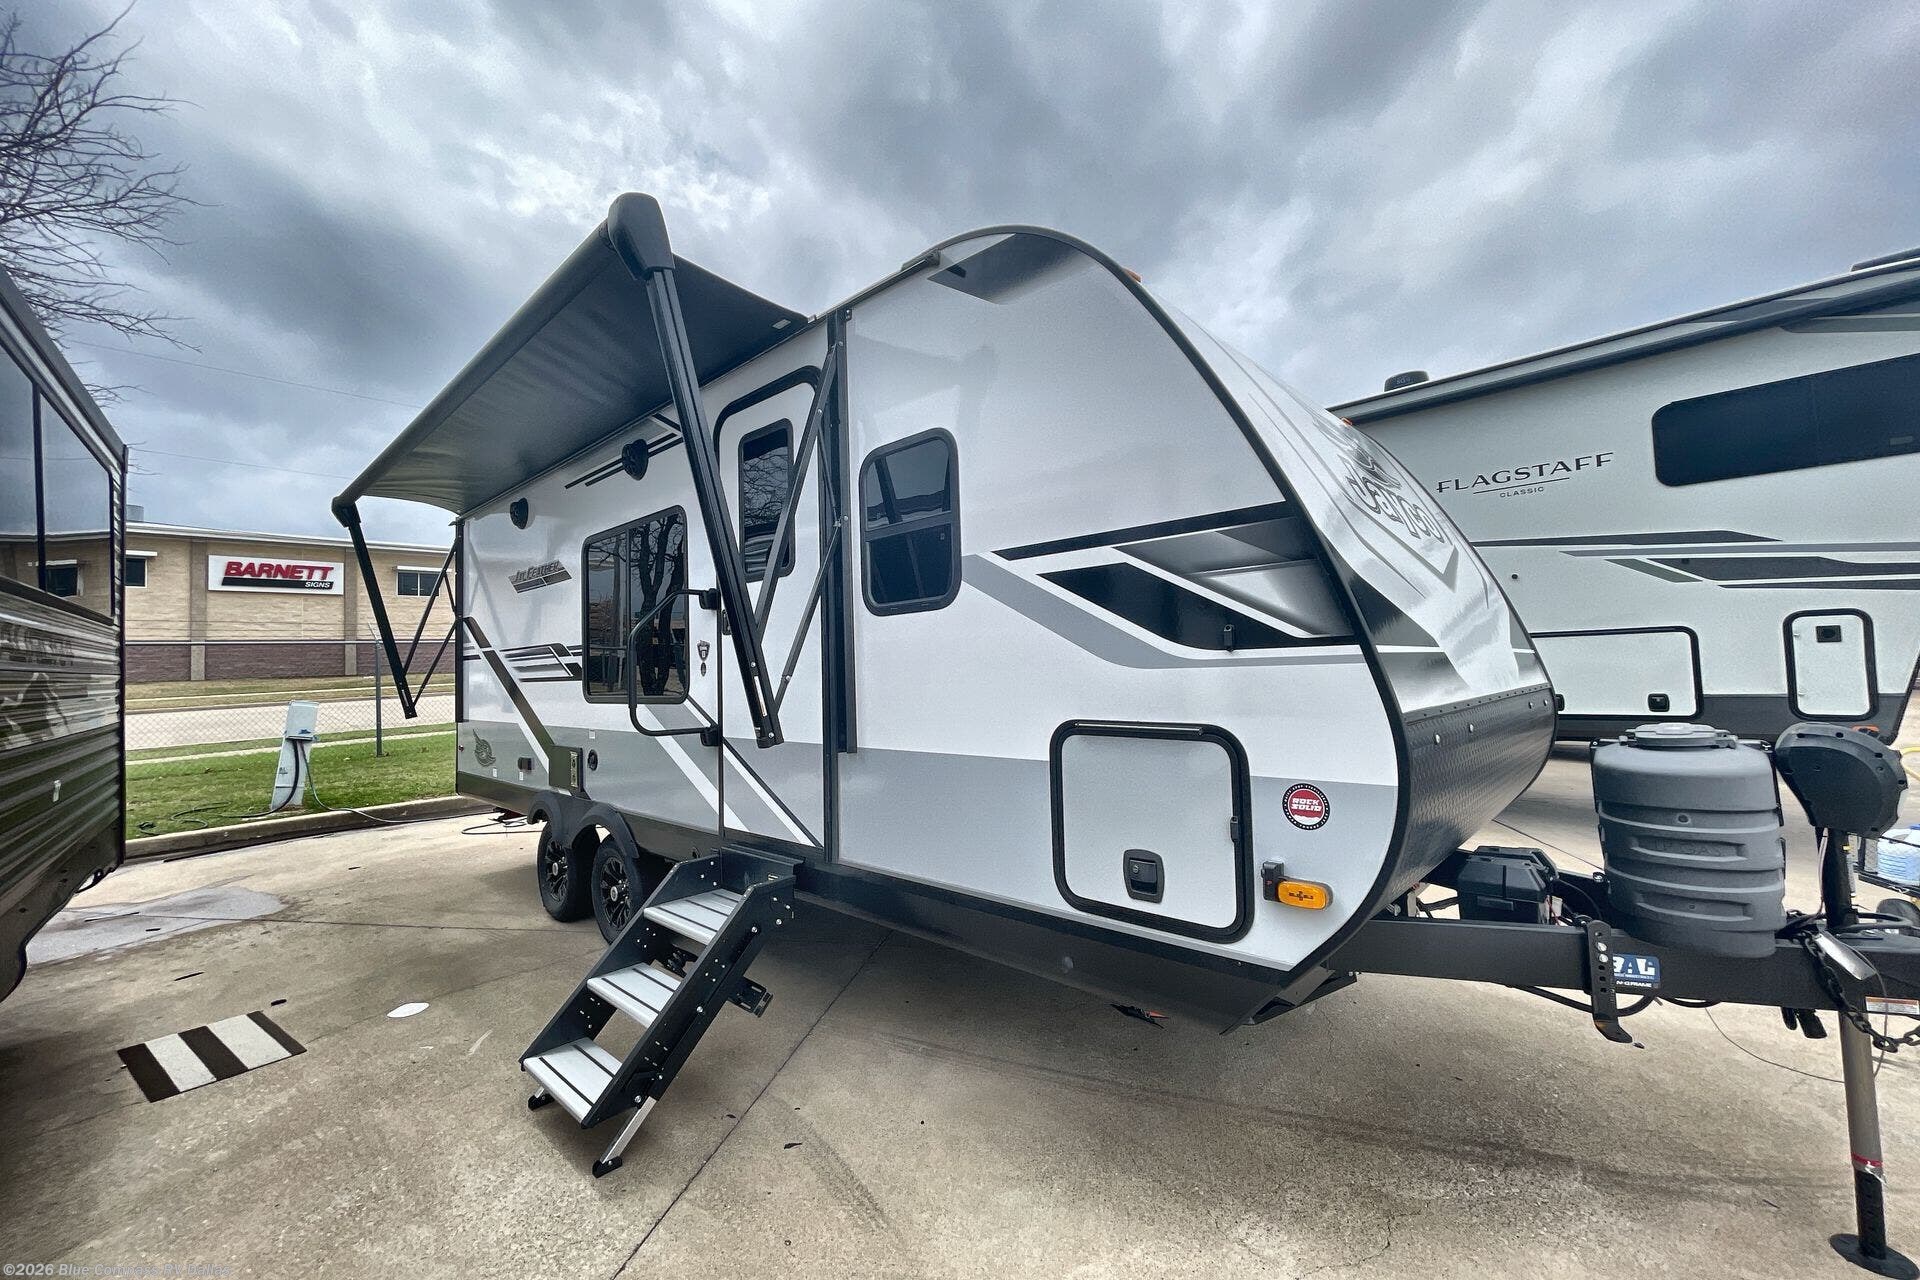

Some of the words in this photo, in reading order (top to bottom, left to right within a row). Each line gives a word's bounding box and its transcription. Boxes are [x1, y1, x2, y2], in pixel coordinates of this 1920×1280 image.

[1436, 452, 1614, 493] FLAGSTAFF
[1500, 487, 1545, 498] CLASSIC
[224, 561, 334, 581] BARNETT
[1292, 797, 1320, 806] ROCK
[1290, 803, 1322, 812] SOLID
